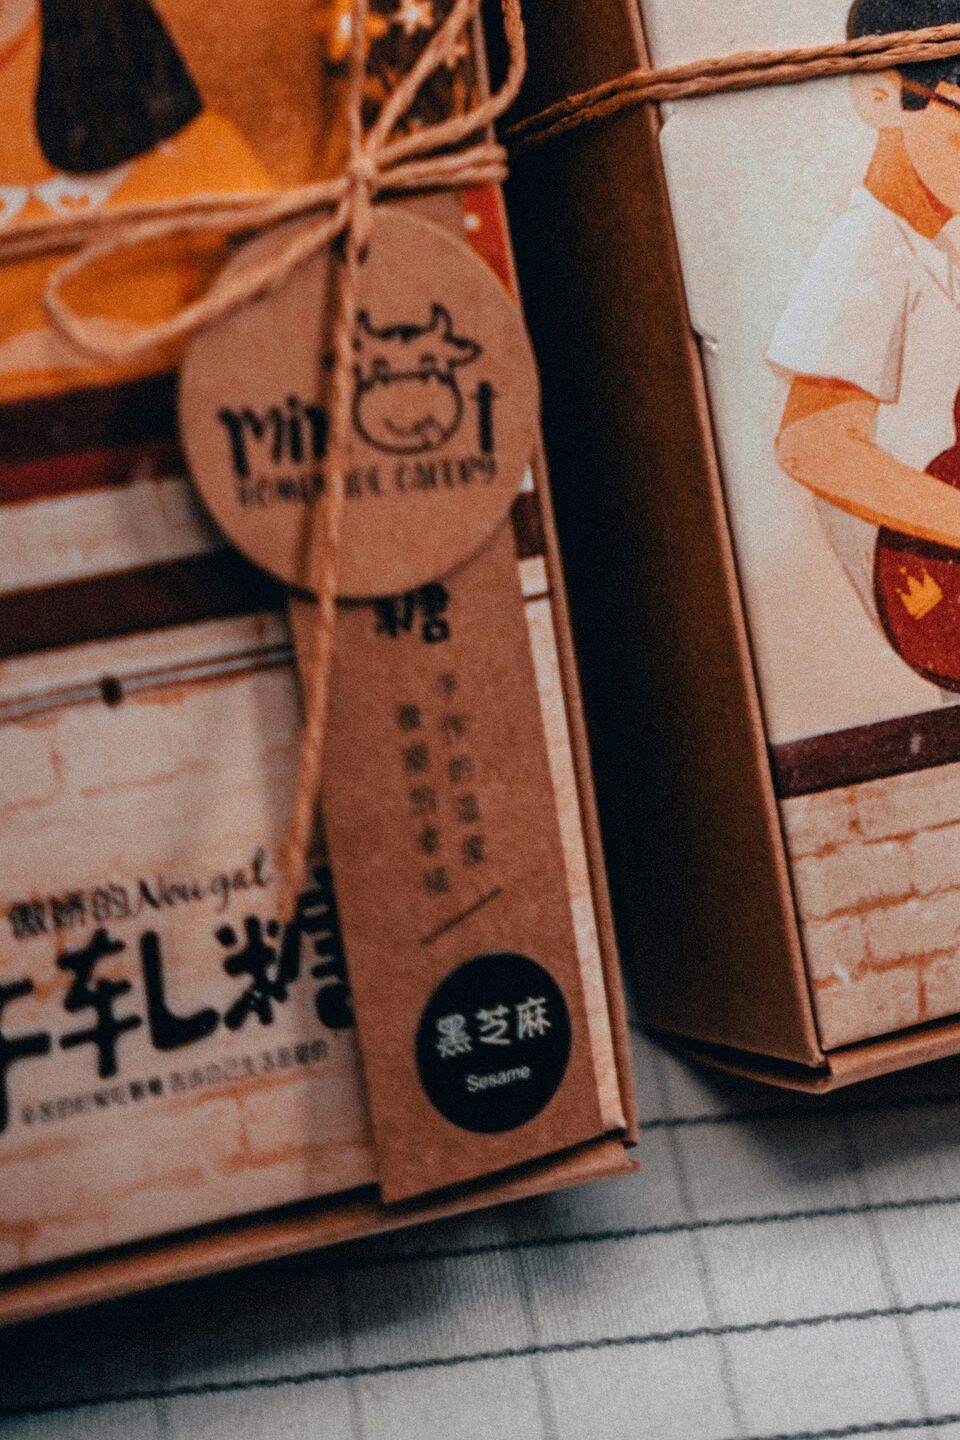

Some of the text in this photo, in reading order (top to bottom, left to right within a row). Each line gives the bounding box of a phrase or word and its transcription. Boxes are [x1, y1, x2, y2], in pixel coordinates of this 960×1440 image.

[436, 995, 552, 1058] 黑芝麻
[466, 1065, 531, 1093] Sesame
